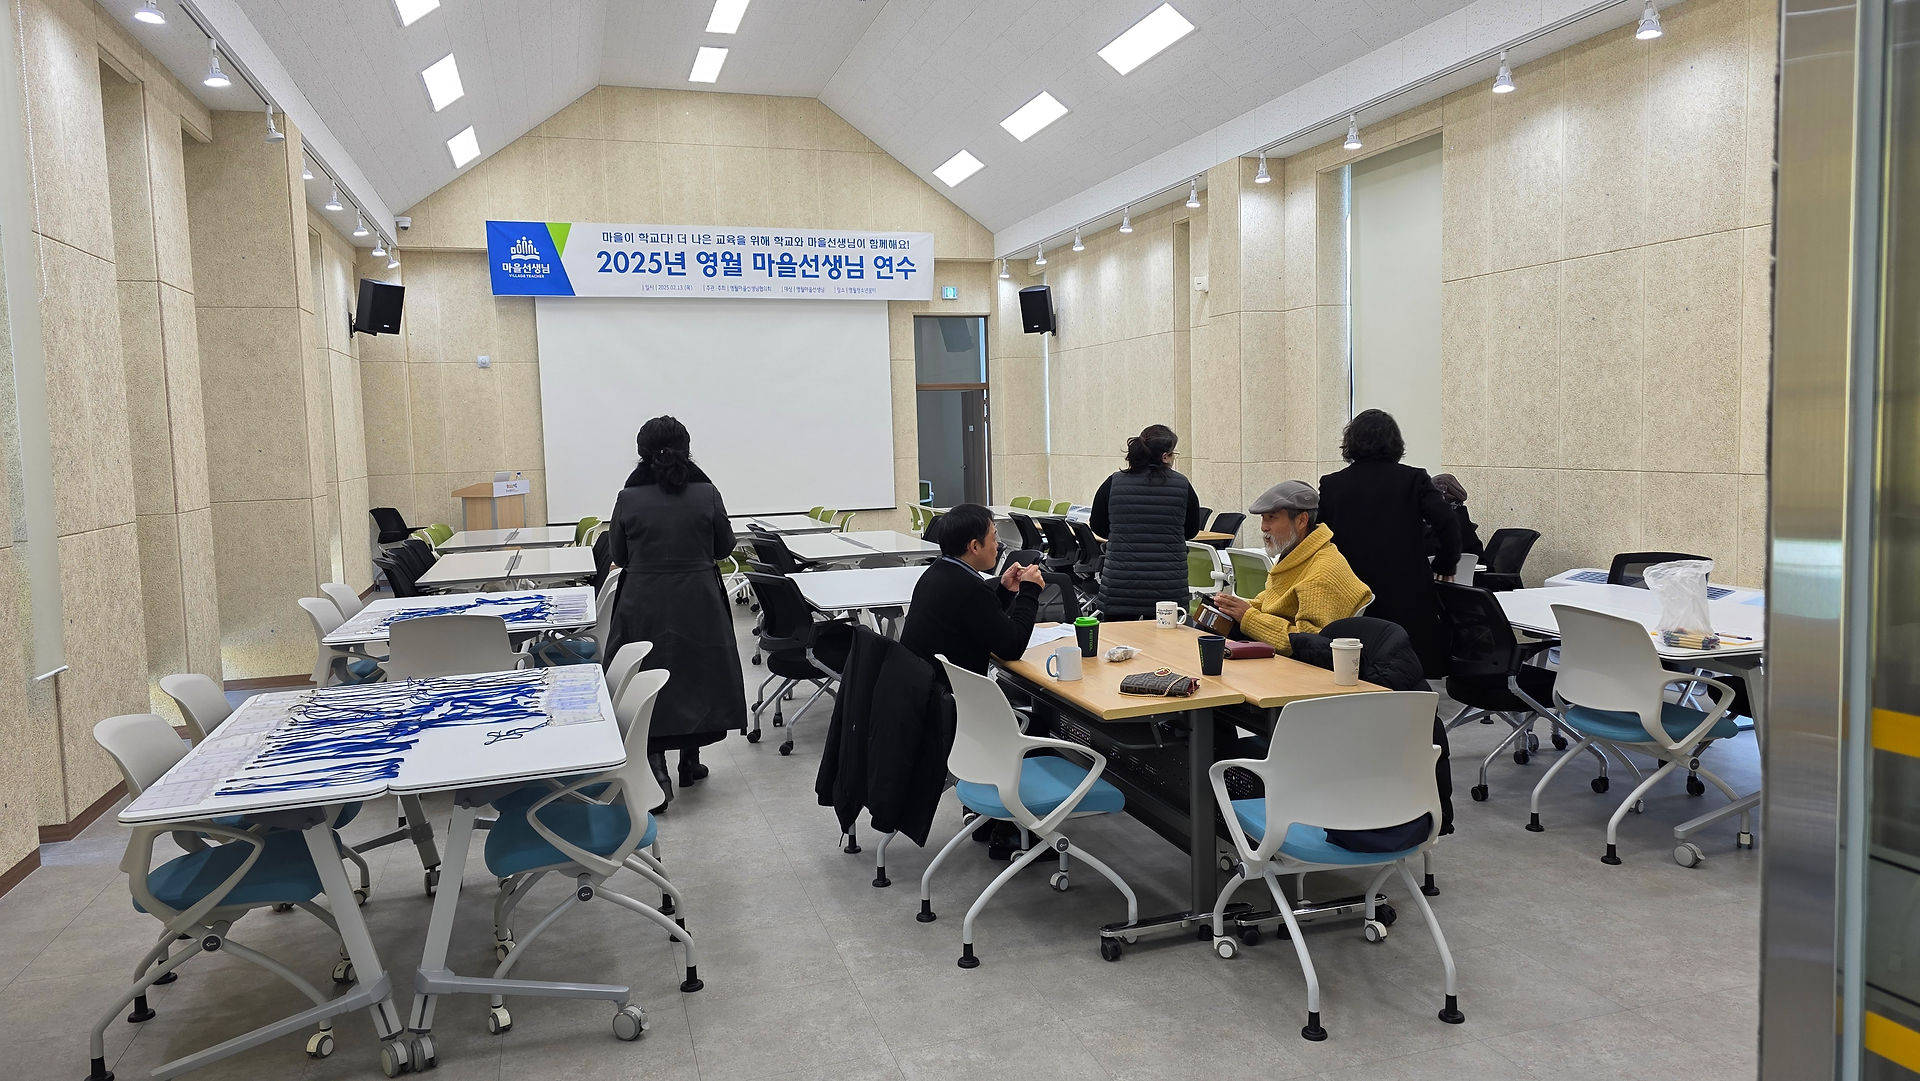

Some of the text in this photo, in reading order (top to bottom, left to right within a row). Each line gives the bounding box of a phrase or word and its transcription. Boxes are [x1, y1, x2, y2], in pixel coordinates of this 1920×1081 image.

[602, 232, 910, 250] 마을이 학교다! 더 나은 교육을 위해 학교와 마을선생님이 함께해요!
[502, 262, 550, 274] 마을선생님
[596, 251, 917, 280] 2025년 영월 마을선생님 연수
